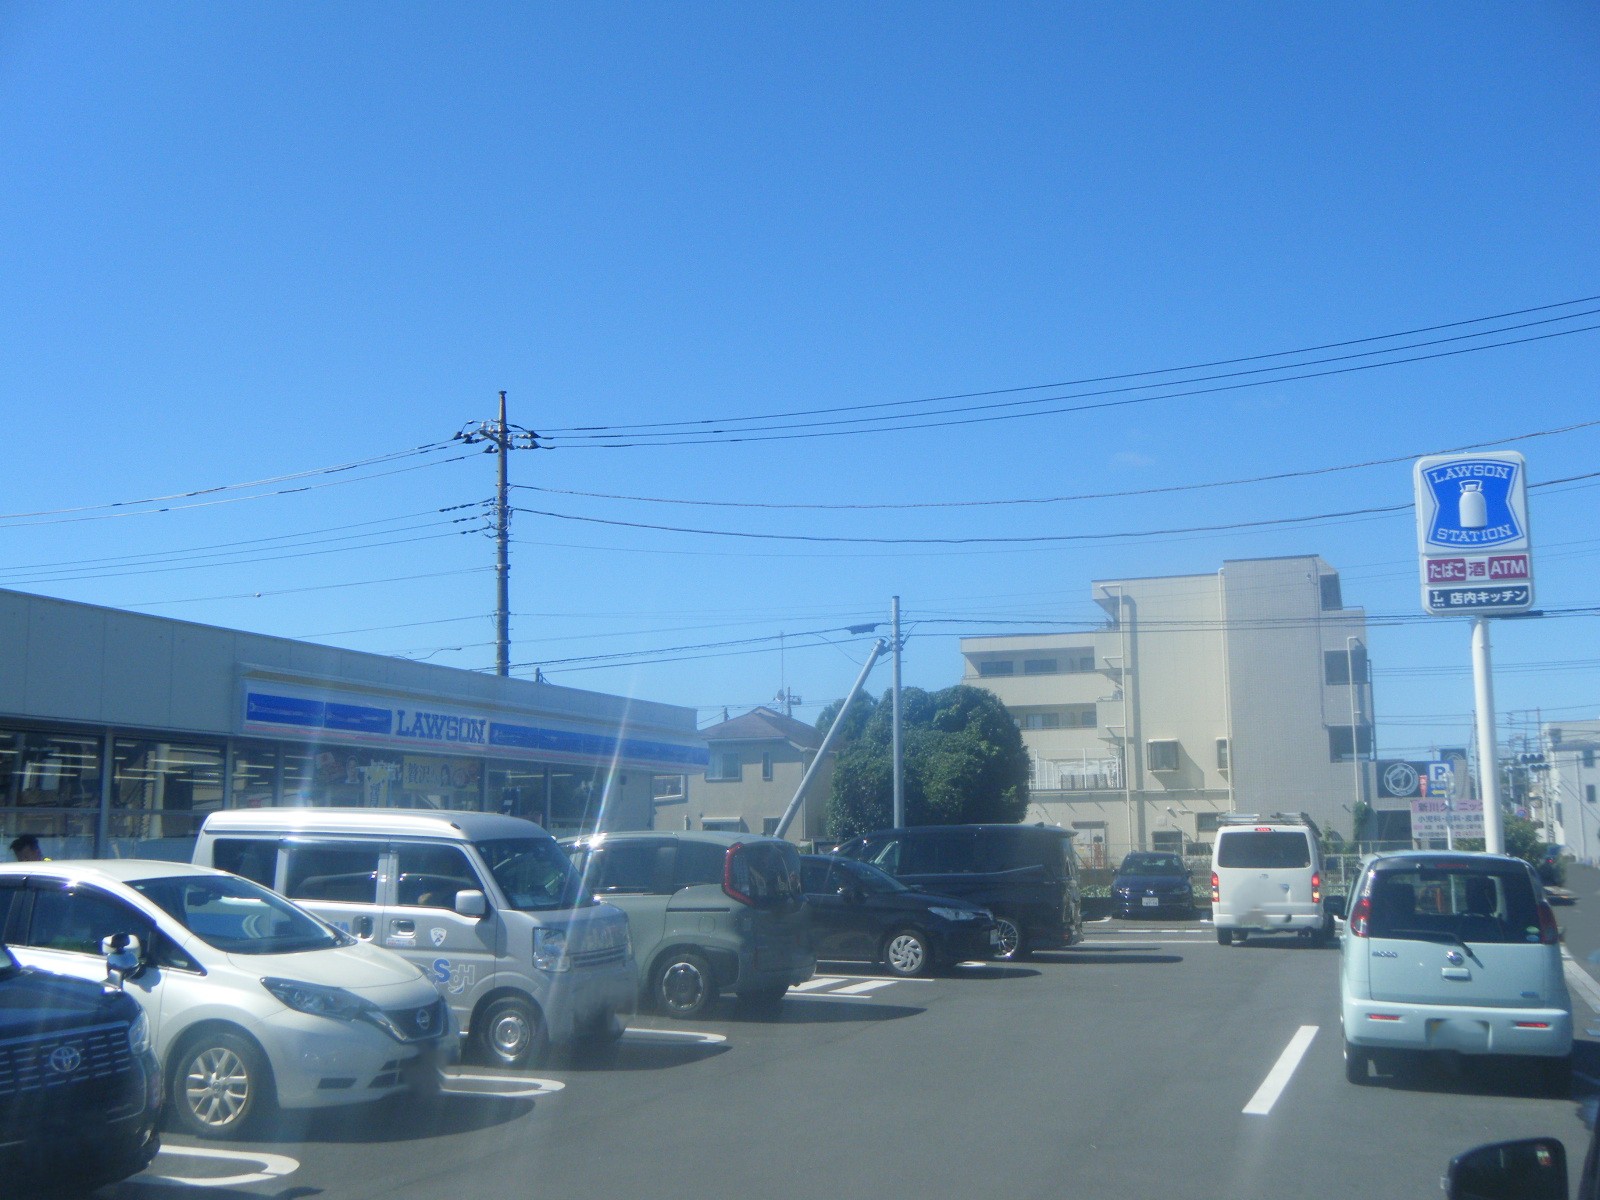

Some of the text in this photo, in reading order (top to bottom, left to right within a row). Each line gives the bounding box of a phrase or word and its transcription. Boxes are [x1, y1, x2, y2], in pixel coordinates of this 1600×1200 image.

[1431, 465, 1510, 484] LAWSON
[1436, 524, 1513, 542] STATION
[1429, 560, 1525, 579] たばこ 酒 ATM
[1432, 590, 1527, 605] L 店内キッチン
[396, 709, 487, 744] LAWSON
[1434, 766, 1446, 781] P
